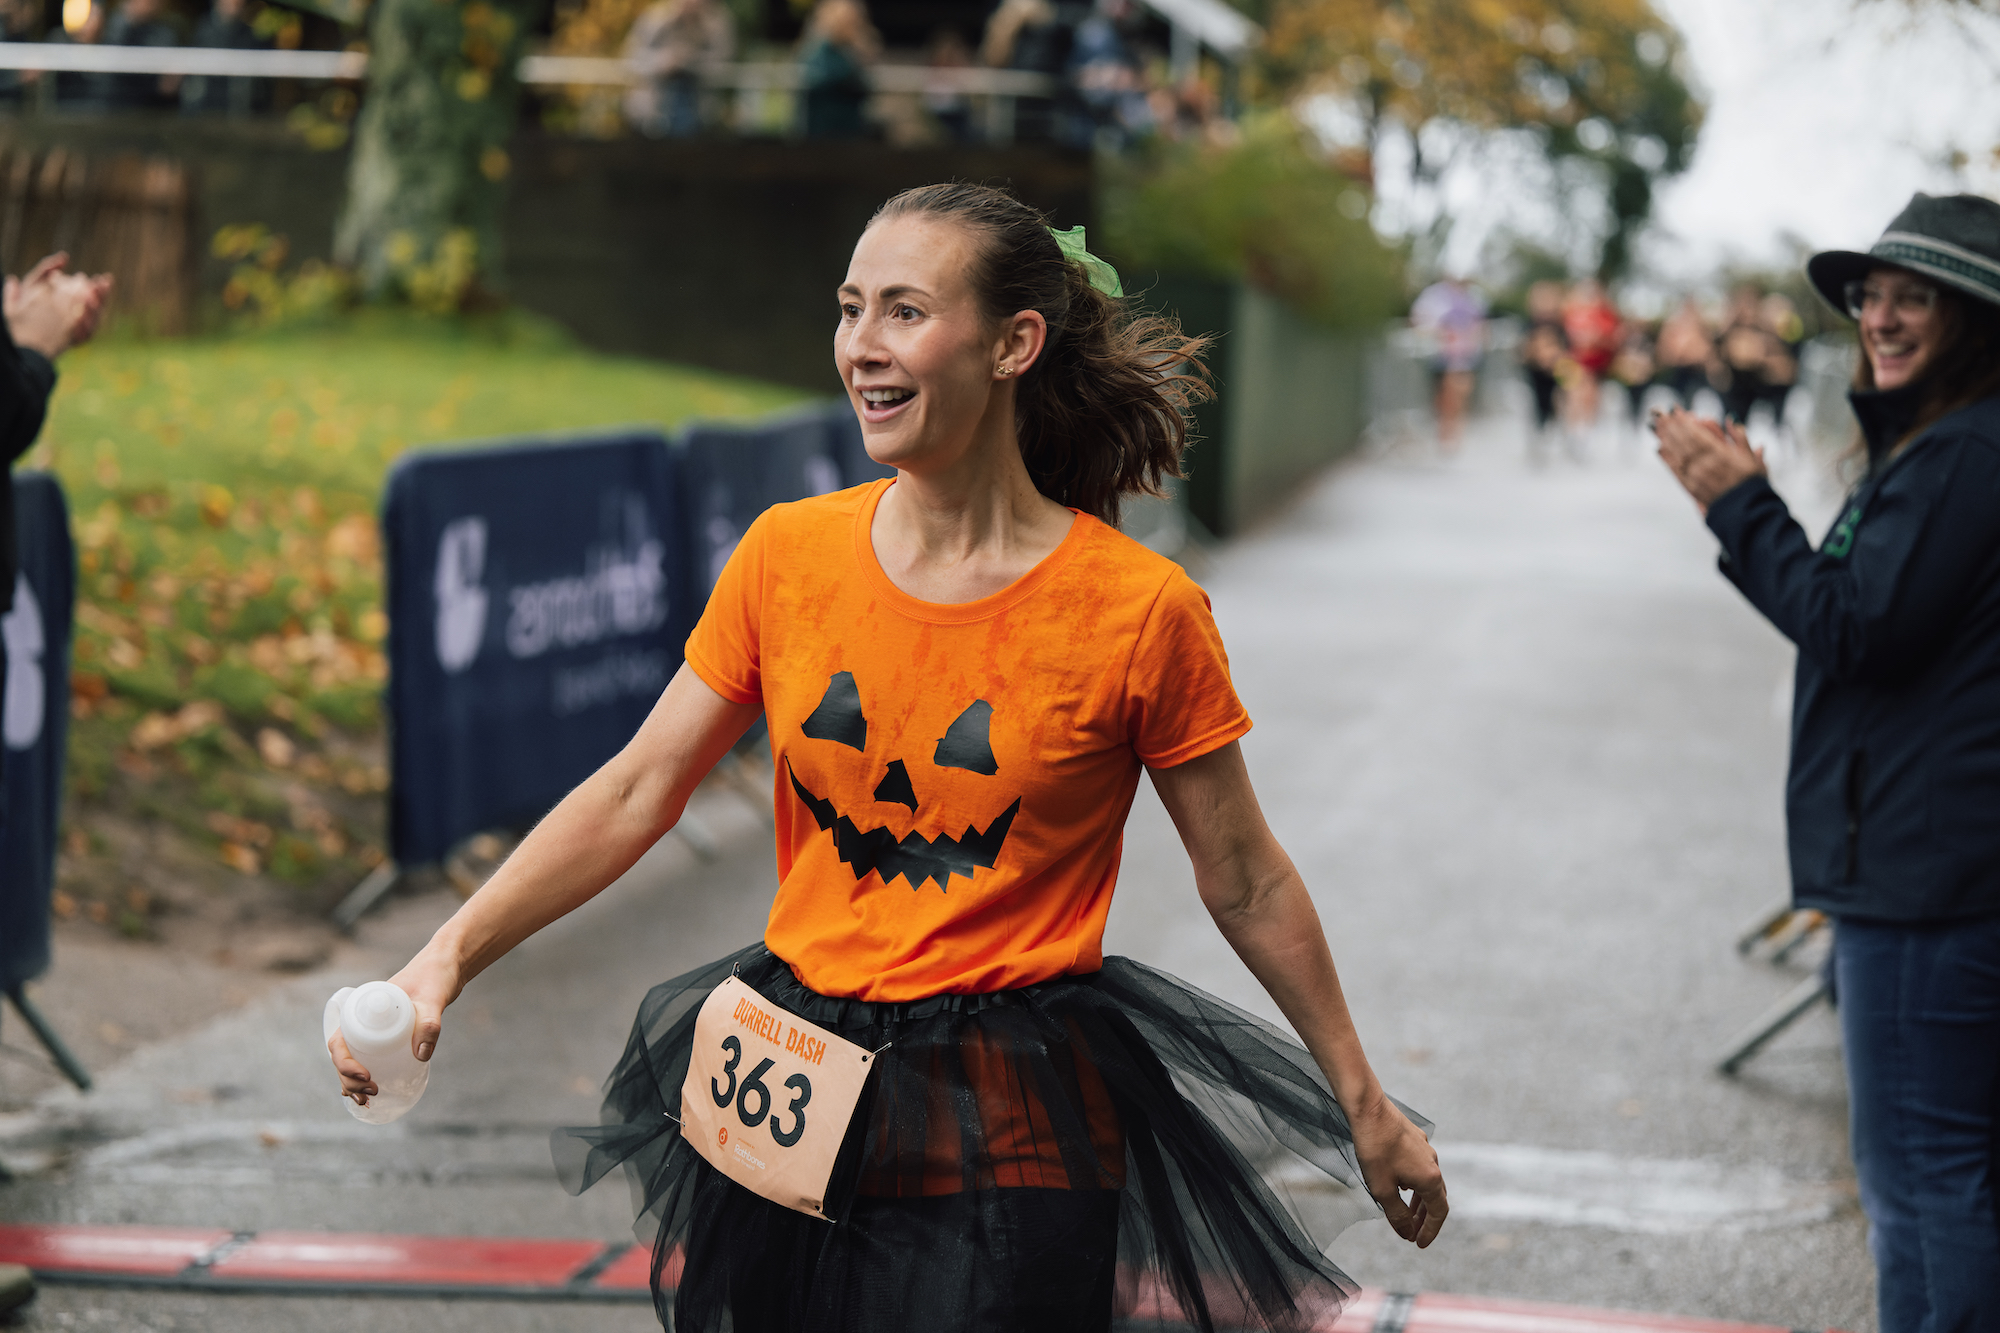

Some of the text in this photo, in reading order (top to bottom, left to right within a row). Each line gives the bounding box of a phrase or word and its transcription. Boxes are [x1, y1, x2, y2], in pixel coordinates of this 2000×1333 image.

[732, 997, 827, 1066] DURRELL DASH
[711, 1035, 812, 1148] 363
[733, 1143, 766, 1170] Rathbones
